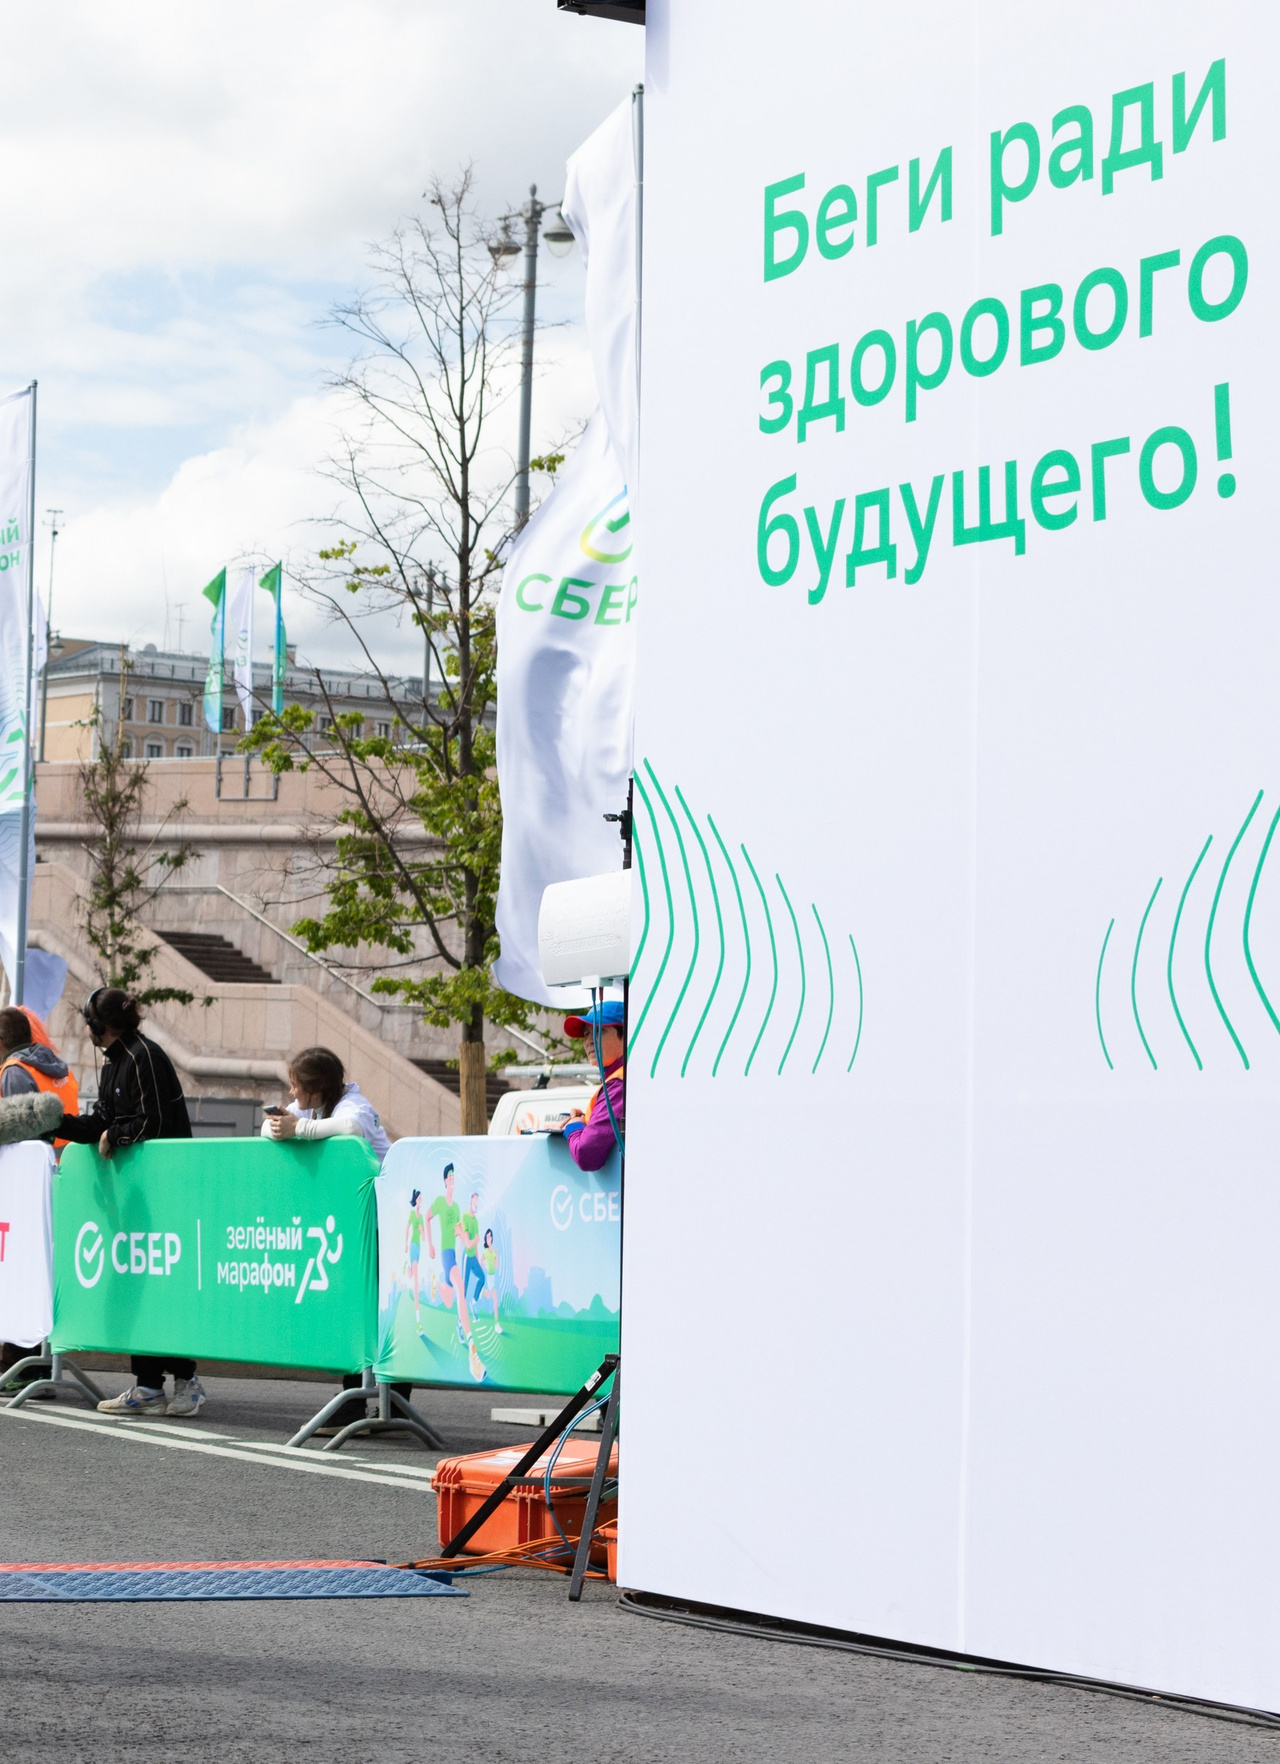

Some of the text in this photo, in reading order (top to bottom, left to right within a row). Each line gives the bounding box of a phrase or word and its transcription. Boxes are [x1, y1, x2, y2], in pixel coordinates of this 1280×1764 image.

[763, 57, 1227, 283] Беги ради
[758, 235, 1249, 444] здорового
[756, 381, 1238, 606] будущего!
[515, 573, 638, 626] СБЕР
[111, 1231, 182, 1276] СБЕР
[226, 1216, 303, 1251] зелёный
[217, 1252, 296, 1294] марафон
